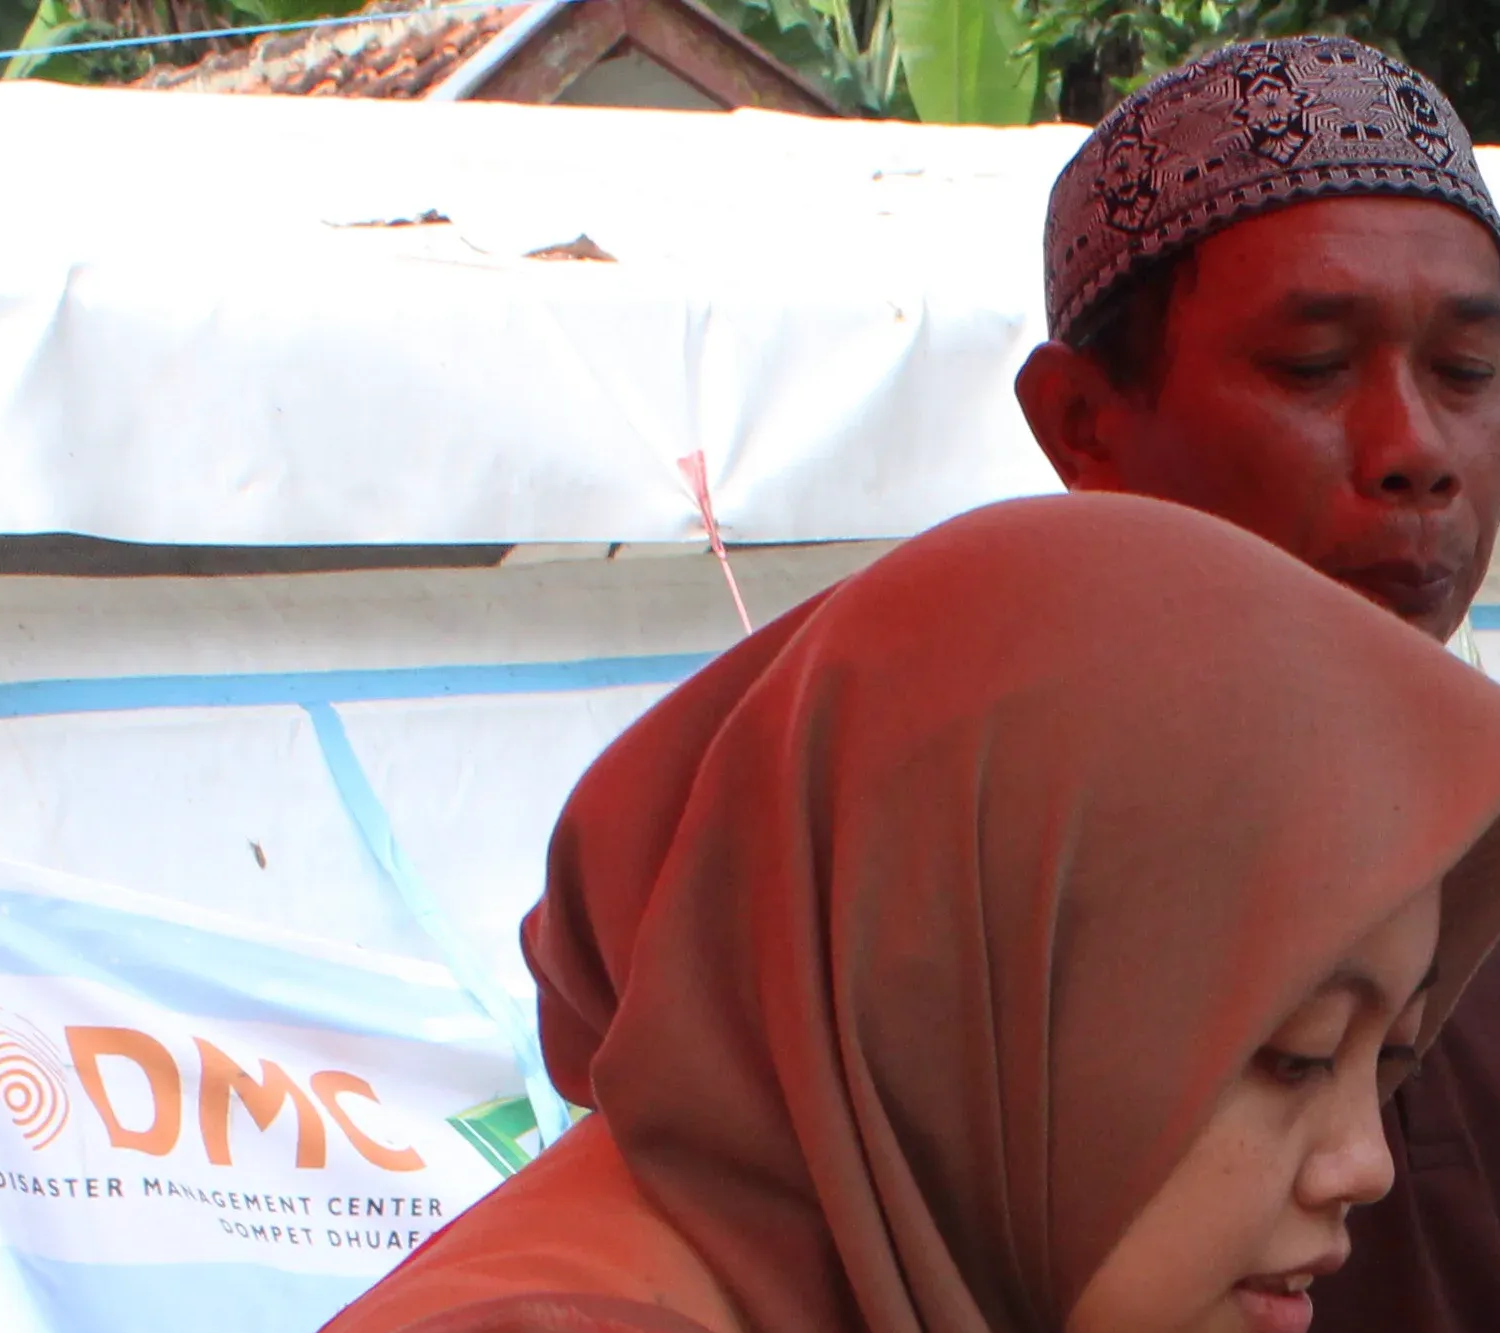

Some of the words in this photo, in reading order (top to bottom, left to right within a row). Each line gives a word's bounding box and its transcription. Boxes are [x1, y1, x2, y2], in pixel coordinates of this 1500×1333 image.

[64, 1025, 426, 1172] DMC
[142, 1176, 312, 1216] MANAGEMENT
[327, 1196, 443, 1218] CENTER
[217, 1217, 314, 1247] DOMPET
[326, 1229, 438, 1251] DHUAF
